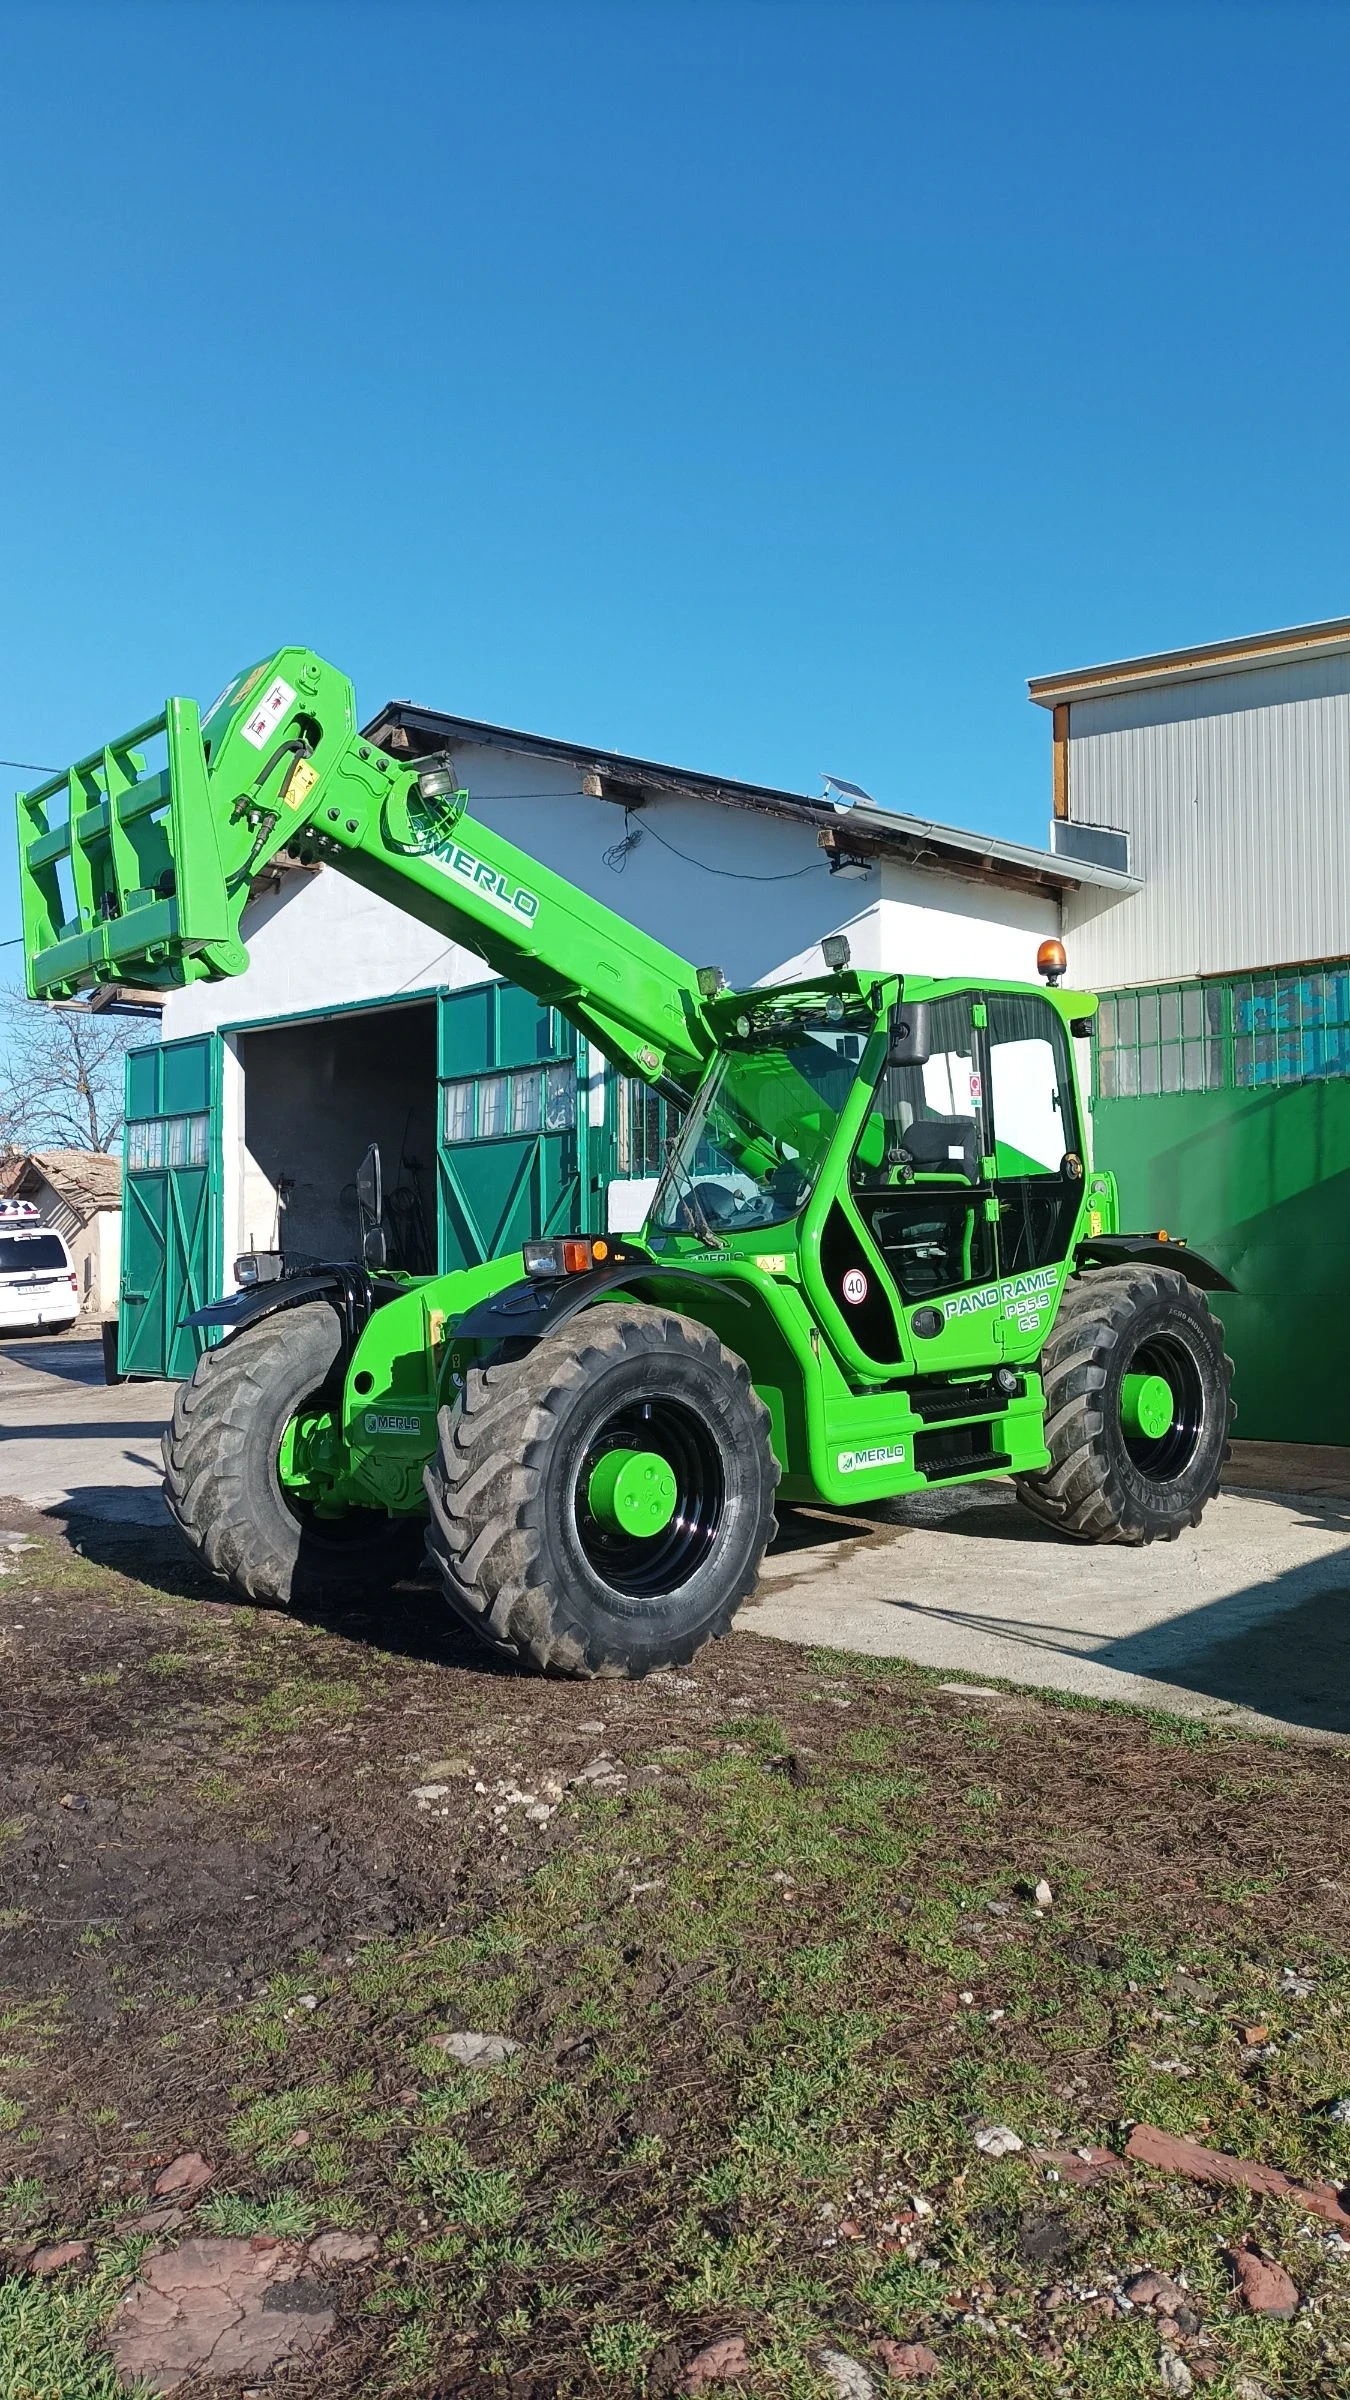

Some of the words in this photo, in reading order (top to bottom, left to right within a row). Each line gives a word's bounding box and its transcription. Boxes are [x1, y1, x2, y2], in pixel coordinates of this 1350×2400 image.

[431, 840, 539, 919] MERLO
[847, 1278, 863, 1294] 40
[944, 1269, 1057, 1318] PANORAMIC
[1006, 1294, 1050, 1318] P55.9
[1019, 1315, 1039, 1332] CS
[378, 1416, 420, 1430] MERLO
[855, 1445, 904, 1464] MERLO
